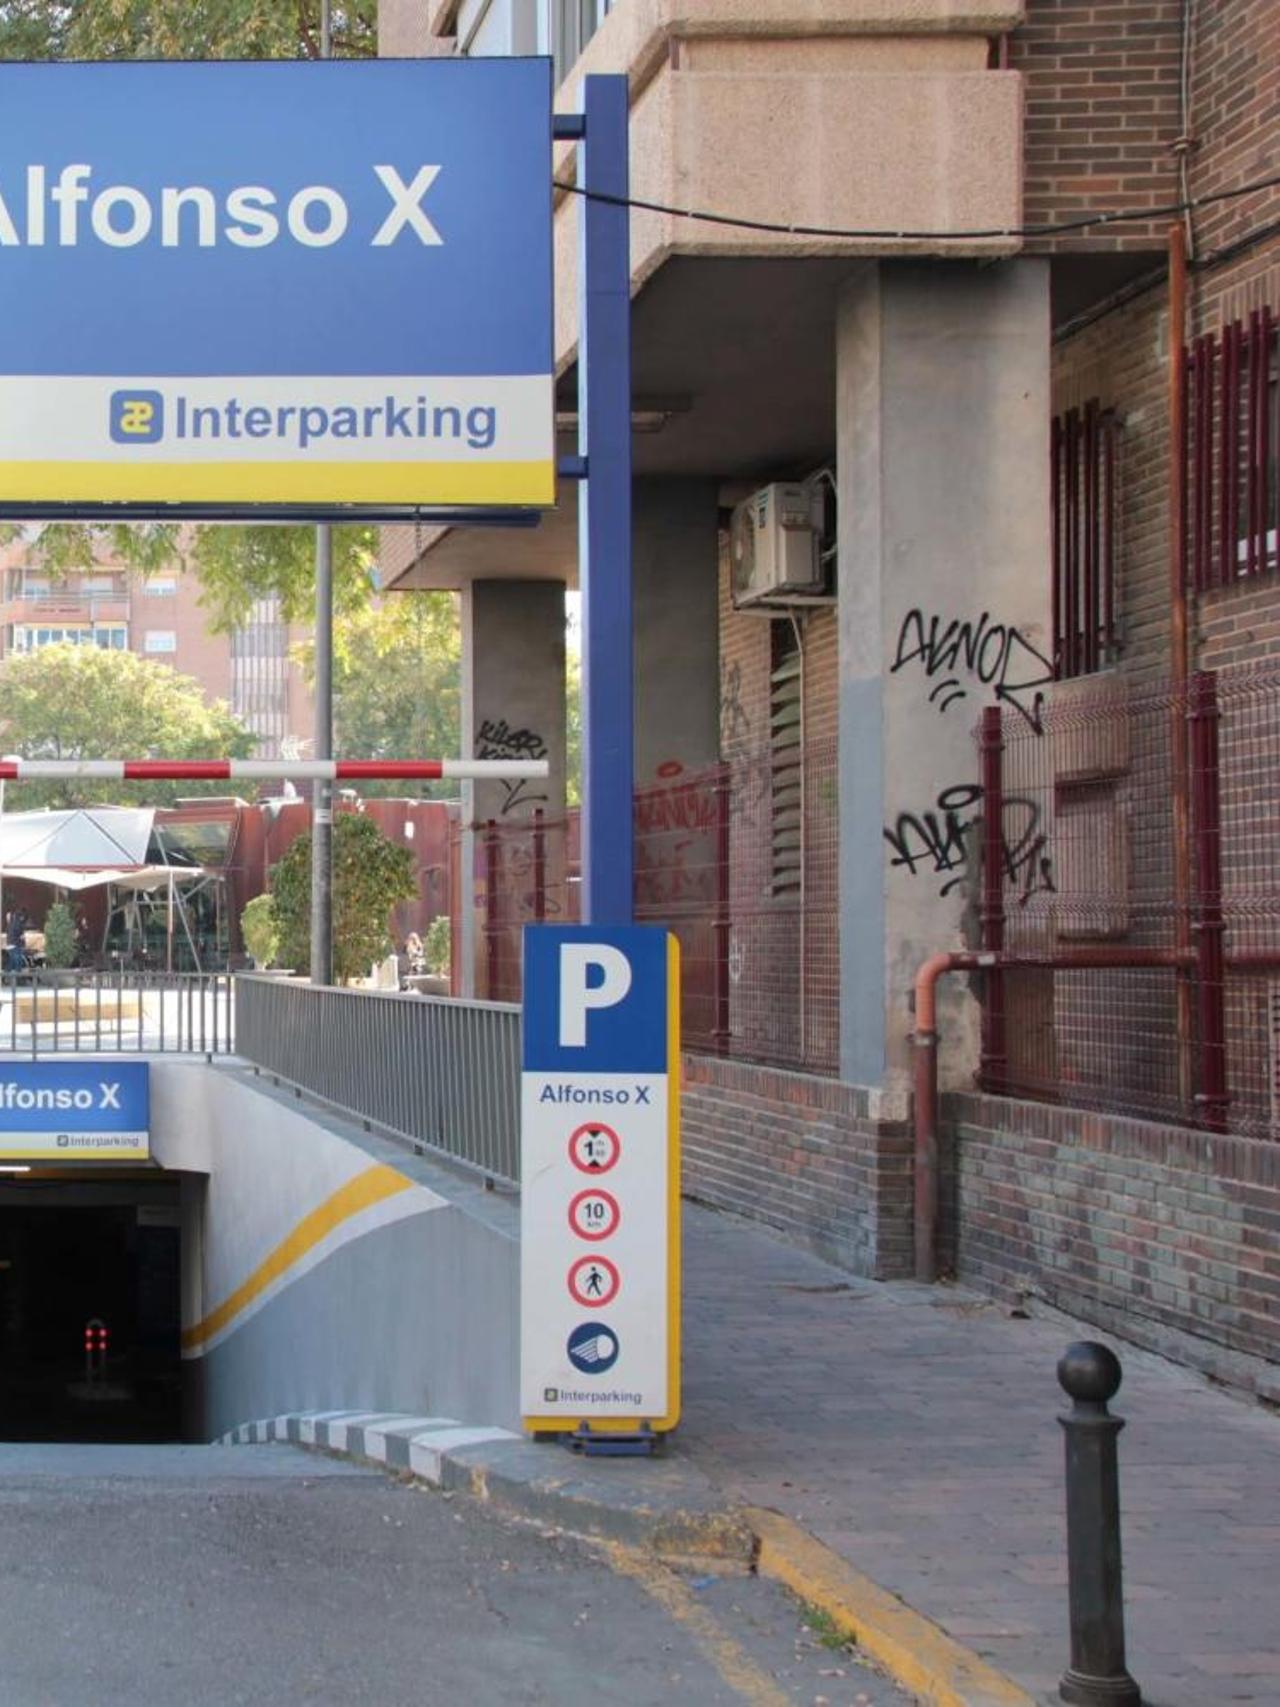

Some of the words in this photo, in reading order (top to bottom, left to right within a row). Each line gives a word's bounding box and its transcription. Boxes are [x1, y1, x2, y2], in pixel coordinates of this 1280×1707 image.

[370, 164, 444, 246] X
[176, 395, 496, 450] Interparking
[559, 943, 632, 1047] P
[98, 1083, 121, 1109] X
[540, 1084, 630, 1104] Alfonso
[635, 1085, 650, 1104] X
[585, 1203, 605, 1219] 10
[560, 1389, 643, 1406] Interparking
